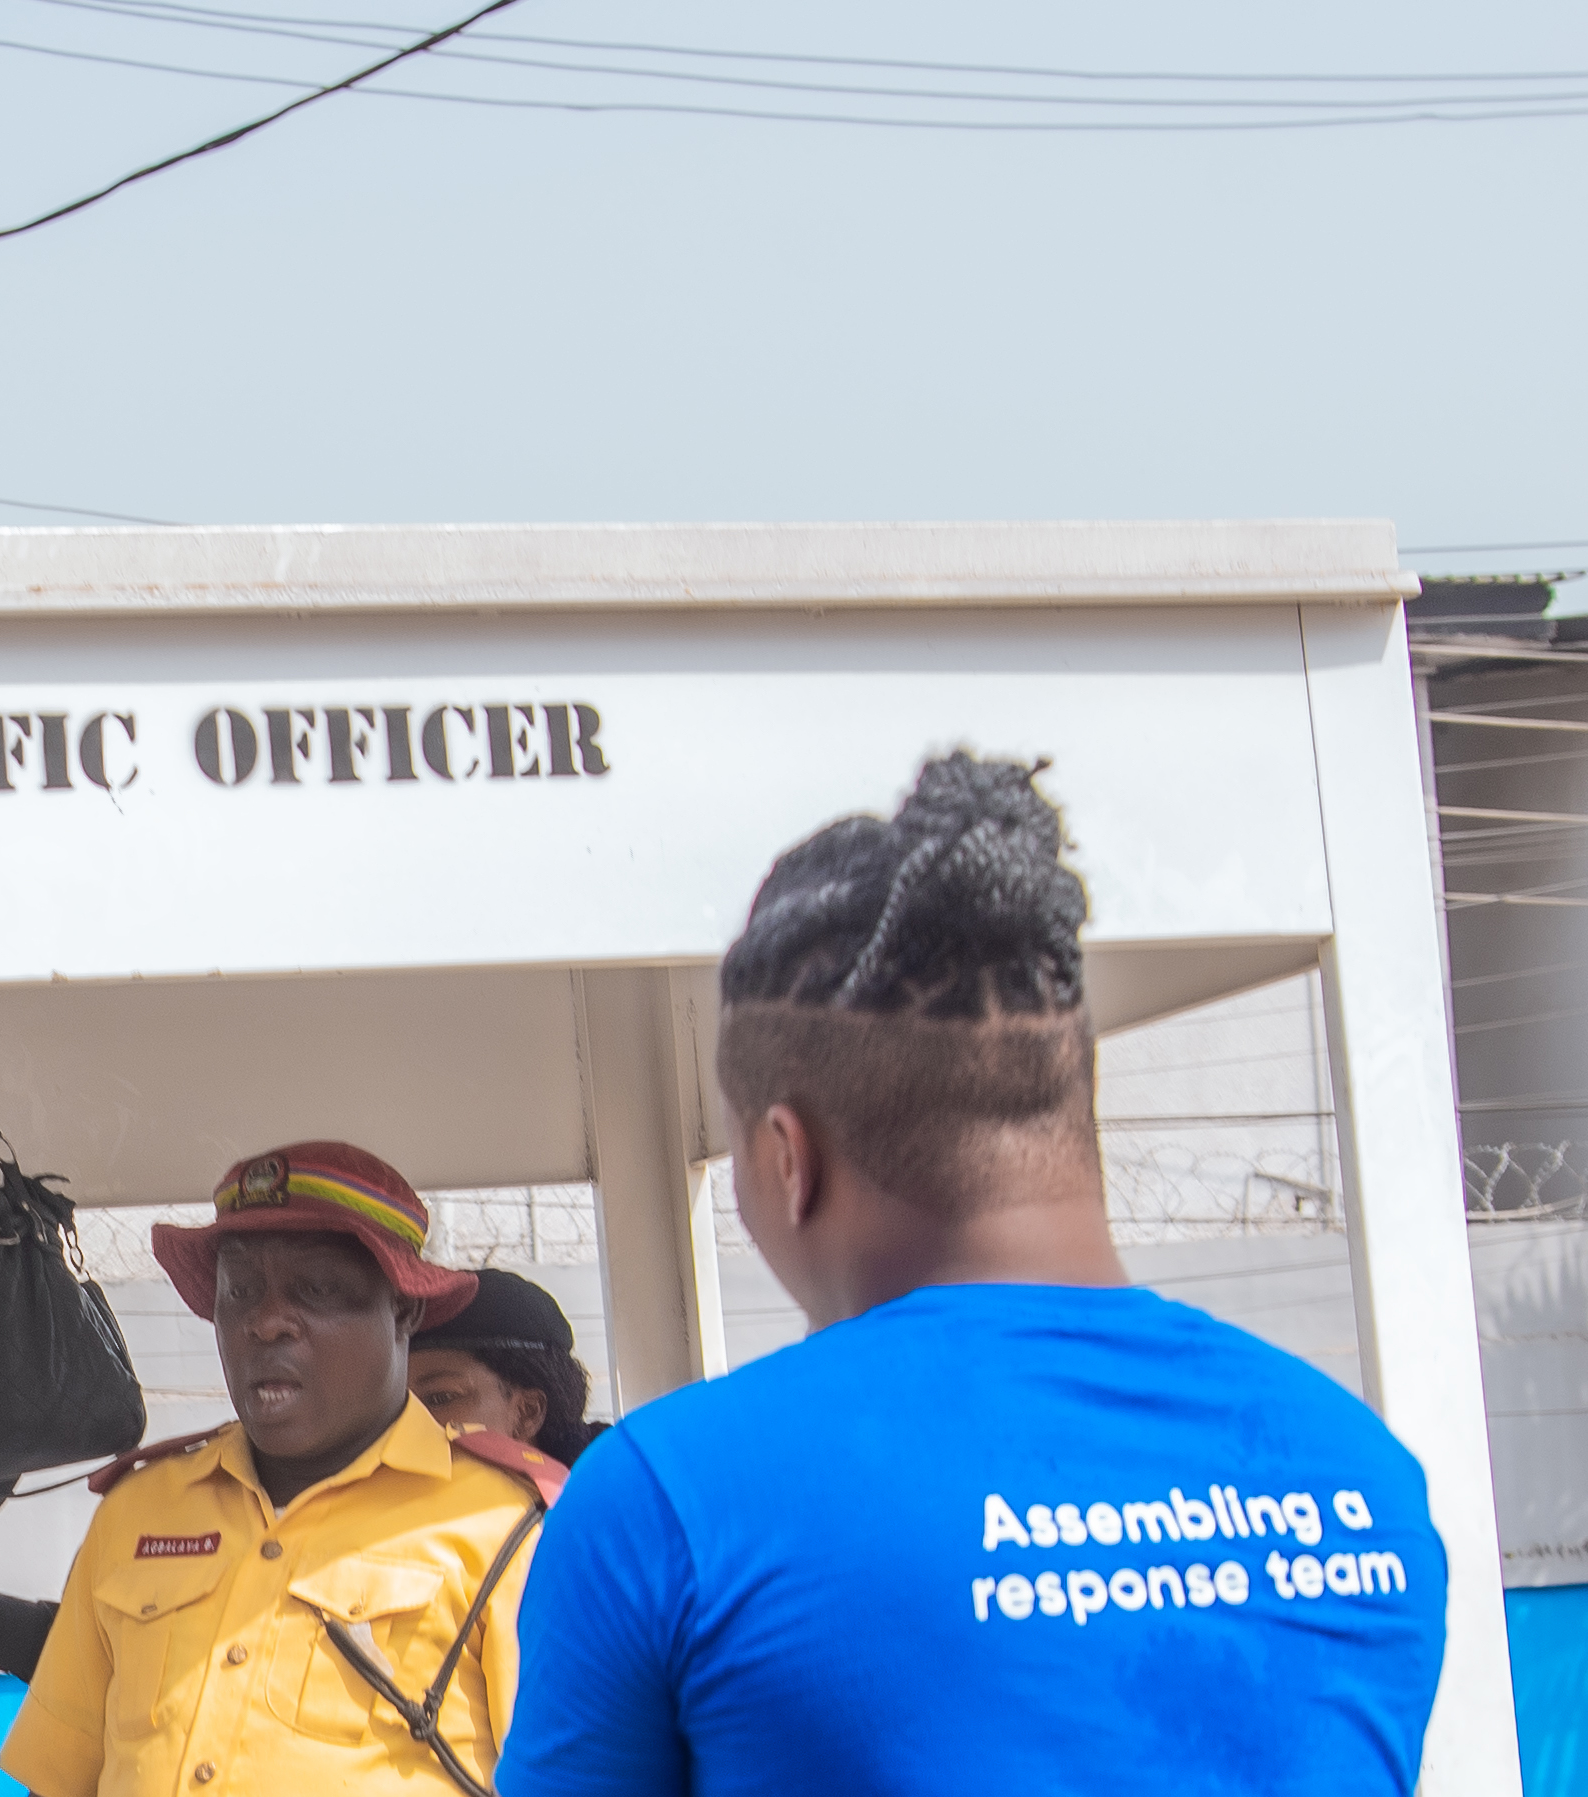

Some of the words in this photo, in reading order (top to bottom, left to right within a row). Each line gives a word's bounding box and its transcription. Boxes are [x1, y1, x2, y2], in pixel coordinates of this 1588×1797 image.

[192, 702, 611, 787] OFFICER
[981, 1483, 1323, 1552] Assembling
[1332, 1488, 1374, 1531] a
[970, 1560, 1251, 1627] response
[1264, 1549, 1408, 1601] team
